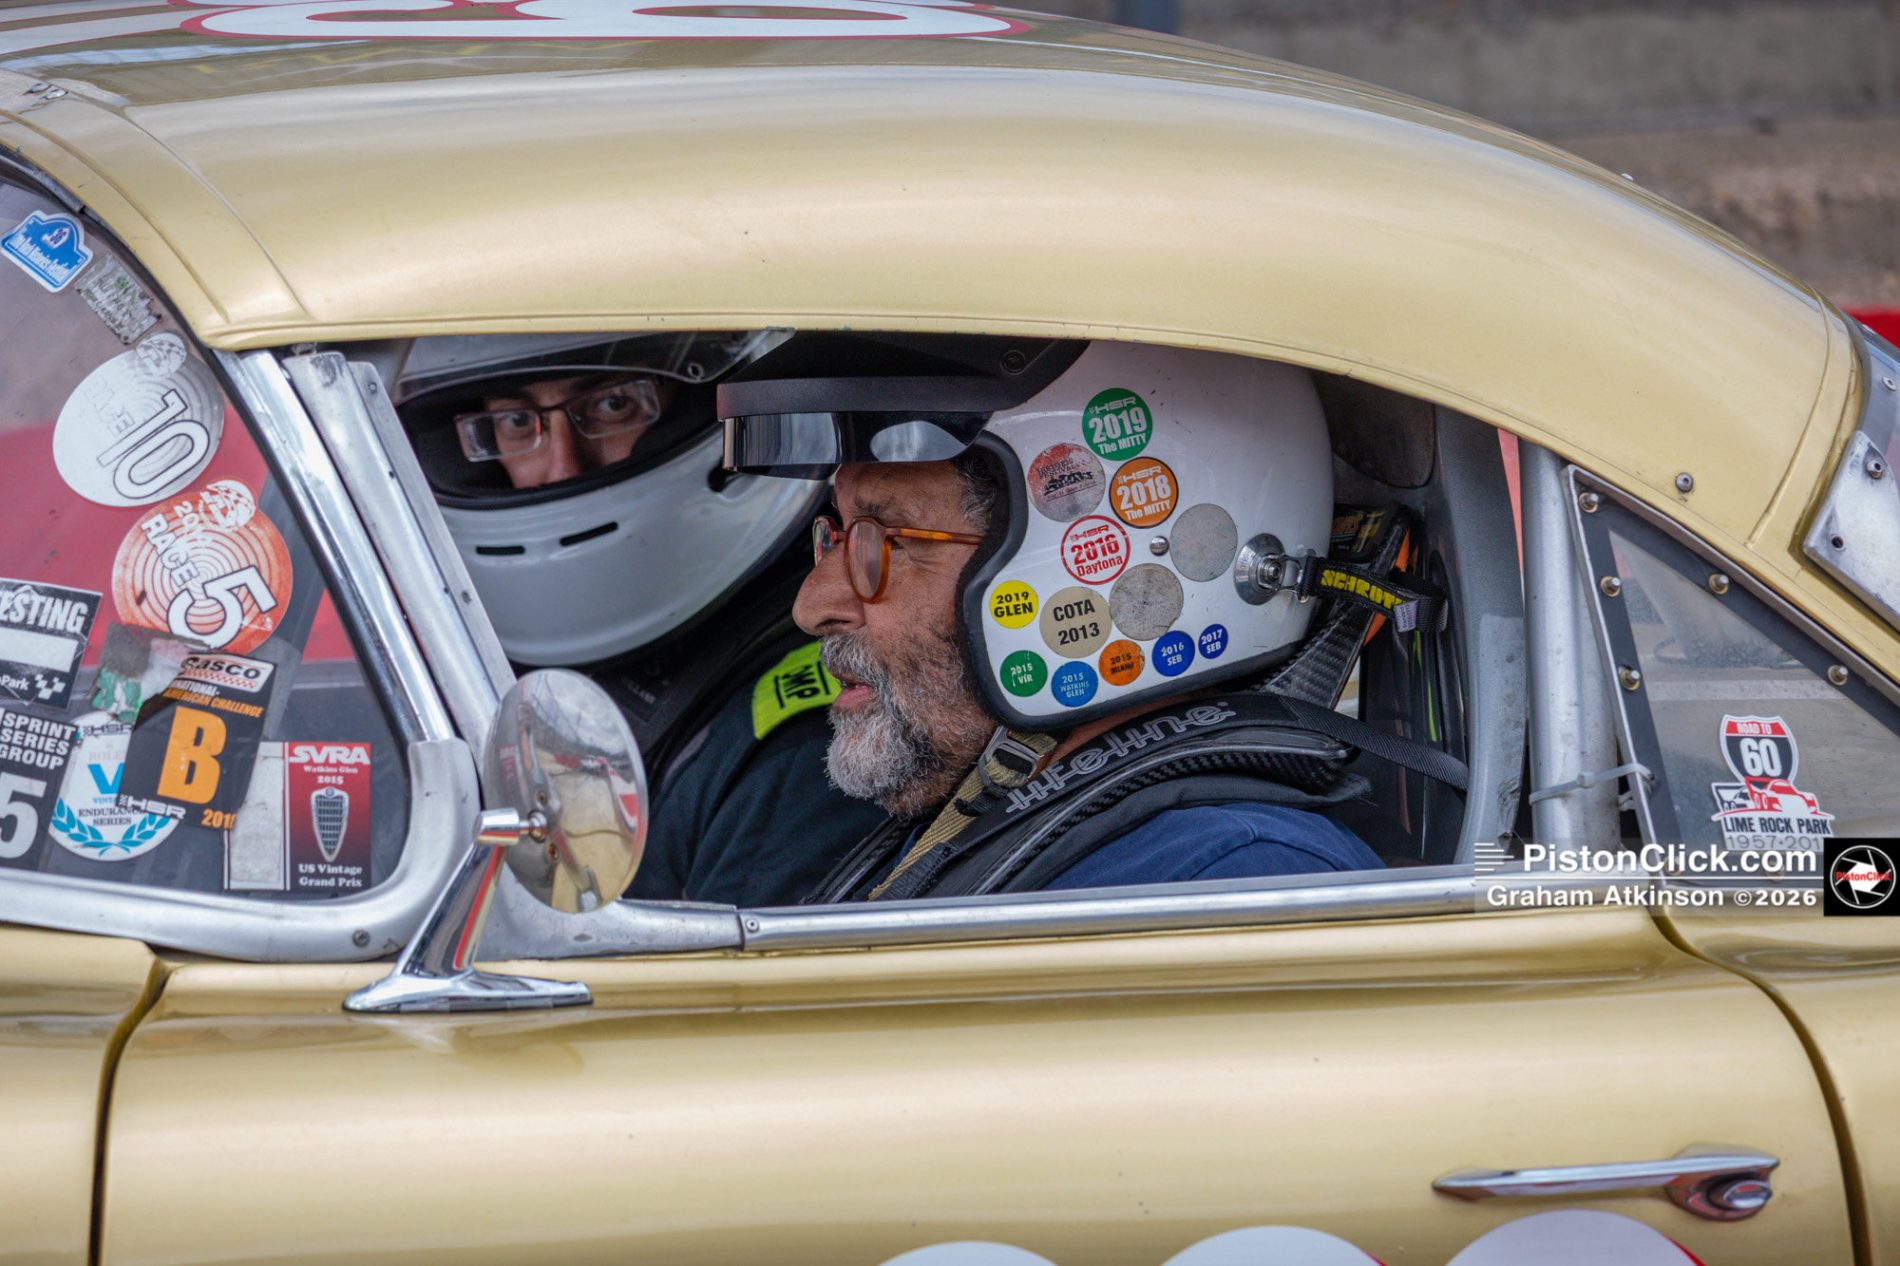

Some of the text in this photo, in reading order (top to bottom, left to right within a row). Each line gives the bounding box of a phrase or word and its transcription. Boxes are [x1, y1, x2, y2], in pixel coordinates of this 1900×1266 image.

[1095, 397, 1137, 414] HSR
[1088, 406, 1148, 444] 2019
[97, 388, 210, 499] 10
[1098, 433, 1146, 454] The MITTY
[1123, 466, 1162, 483] HSR
[1116, 474, 1171, 511] 2018
[1125, 499, 1171, 521] The MITTY
[141, 513, 200, 588] RACE
[1071, 534, 1119, 565] 2016
[1076, 555, 1123, 577] Daytona
[996, 592, 1029, 604] 2019
[1320, 569, 1407, 610] SCHROT
[0, 590, 88, 634] ESTING
[167, 565, 279, 649] 5
[994, 602, 1033, 618] GLEN
[1053, 599, 1095, 622] COTA
[1058, 622, 1100, 645] 2013
[1201, 629, 1223, 645] 2017
[1161, 642, 1184, 657] 2016
[1206, 642, 1221, 654] SEB
[1010, 663, 1033, 675] 2015
[1167, 654, 1182, 666] SEB
[1, 674, 29, 690] Park
[1018, 674, 1033, 684] VIR
[1060, 681, 1089, 692] WATKINS
[1062, 672, 1084, 683] 2015
[1066, 689, 1084, 698] GLEN
[211, 697, 264, 717] CHALLENGE
[2, 713, 76, 741] SPRINT
[1737, 723, 1771, 734] ROAD TO
[0, 728, 70, 755] SERIES
[0, 744, 64, 770] GROUP
[157, 706, 227, 804] B
[289, 745, 370, 765] SVRA
[1739, 738, 1782, 777] 60
[304, 765, 358, 774] Watkins Glen
[317, 776, 344, 785] 2015
[0, 772, 47, 858] 5
[78, 807, 146, 818] ENDURANC
[128, 797, 186, 819] HSR
[92, 817, 132, 826] SERIES
[1723, 817, 1831, 834] LIME ROCK PARK
[298, 864, 362, 876] US Vintage
[299, 877, 362, 887] Grand Prix
